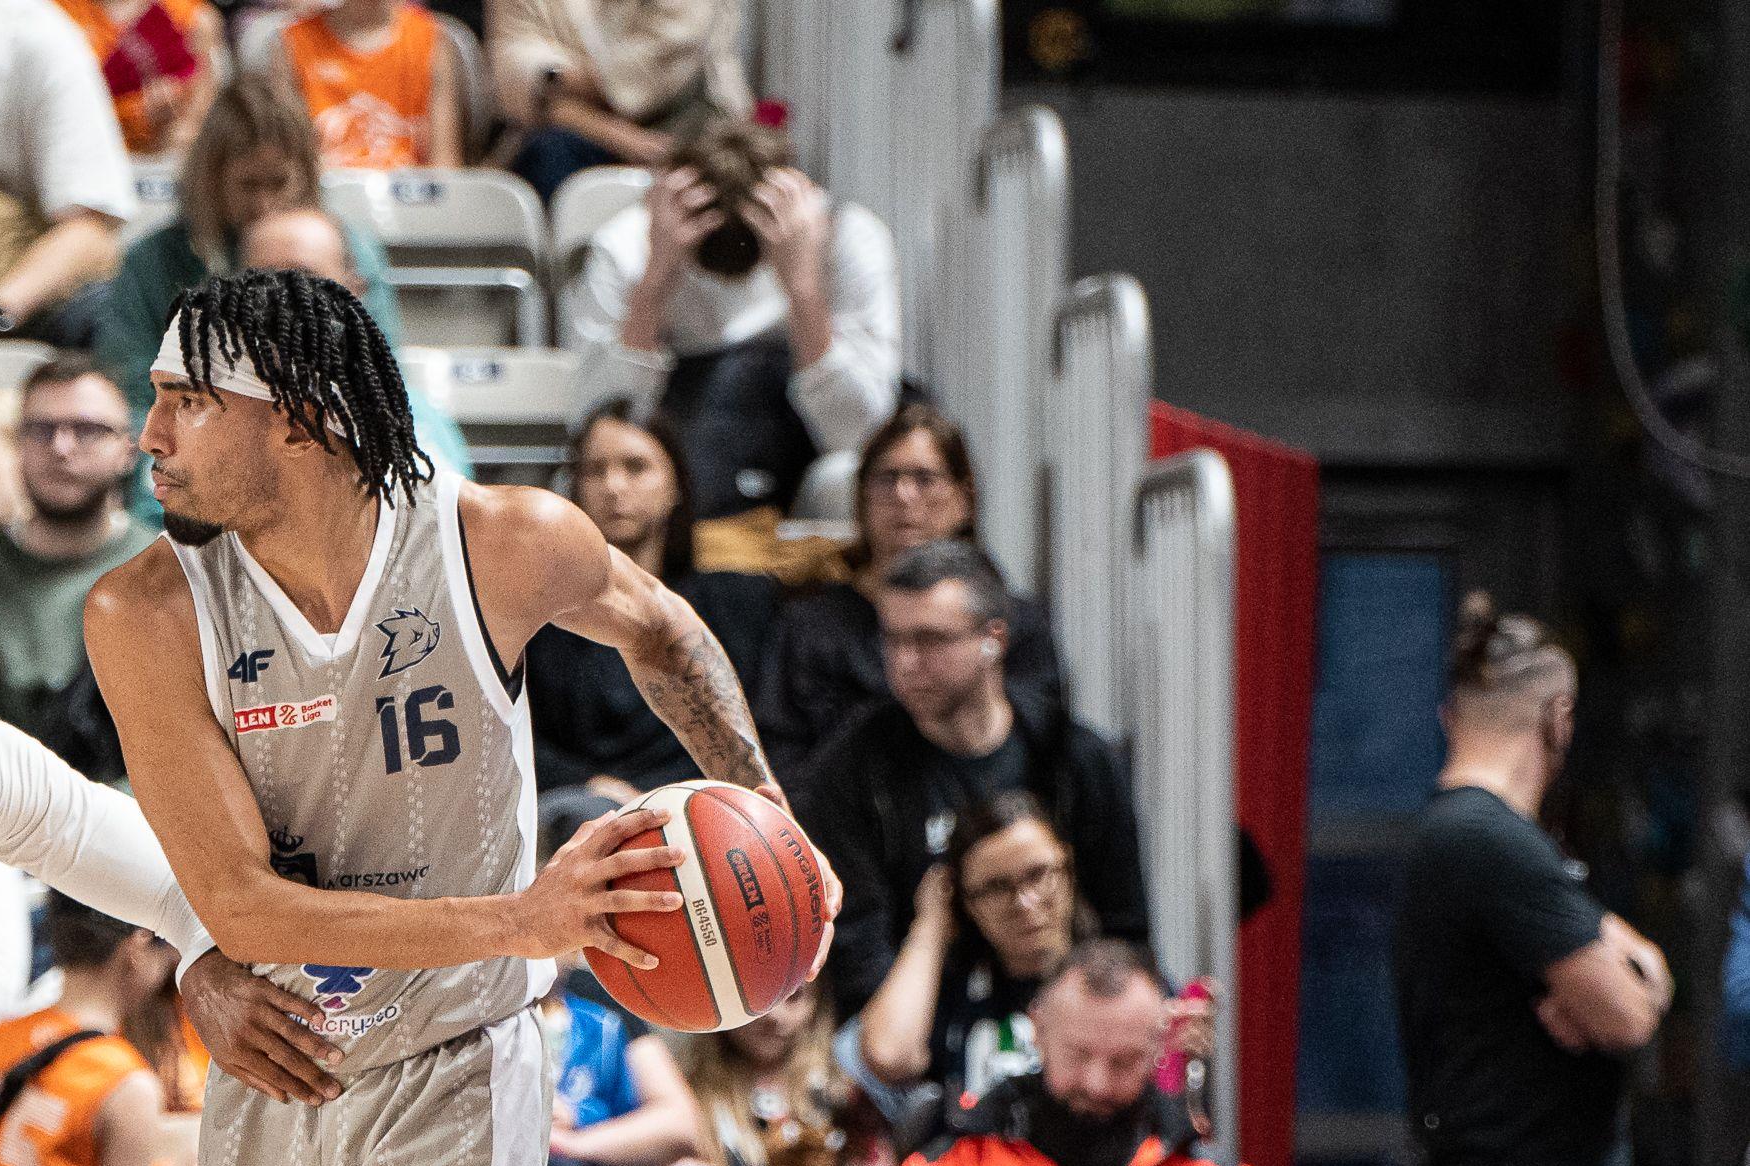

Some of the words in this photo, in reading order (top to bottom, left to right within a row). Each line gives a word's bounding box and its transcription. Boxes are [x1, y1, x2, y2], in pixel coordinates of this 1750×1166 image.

[228, 649, 275, 683] 4F
[234, 711, 271, 729] LEN
[301, 698, 332, 714] Basket
[302, 710, 321, 722] Liga
[376, 685, 460, 775] 16
[779, 827, 824, 935] molten
[693, 898, 718, 948] BG4550
